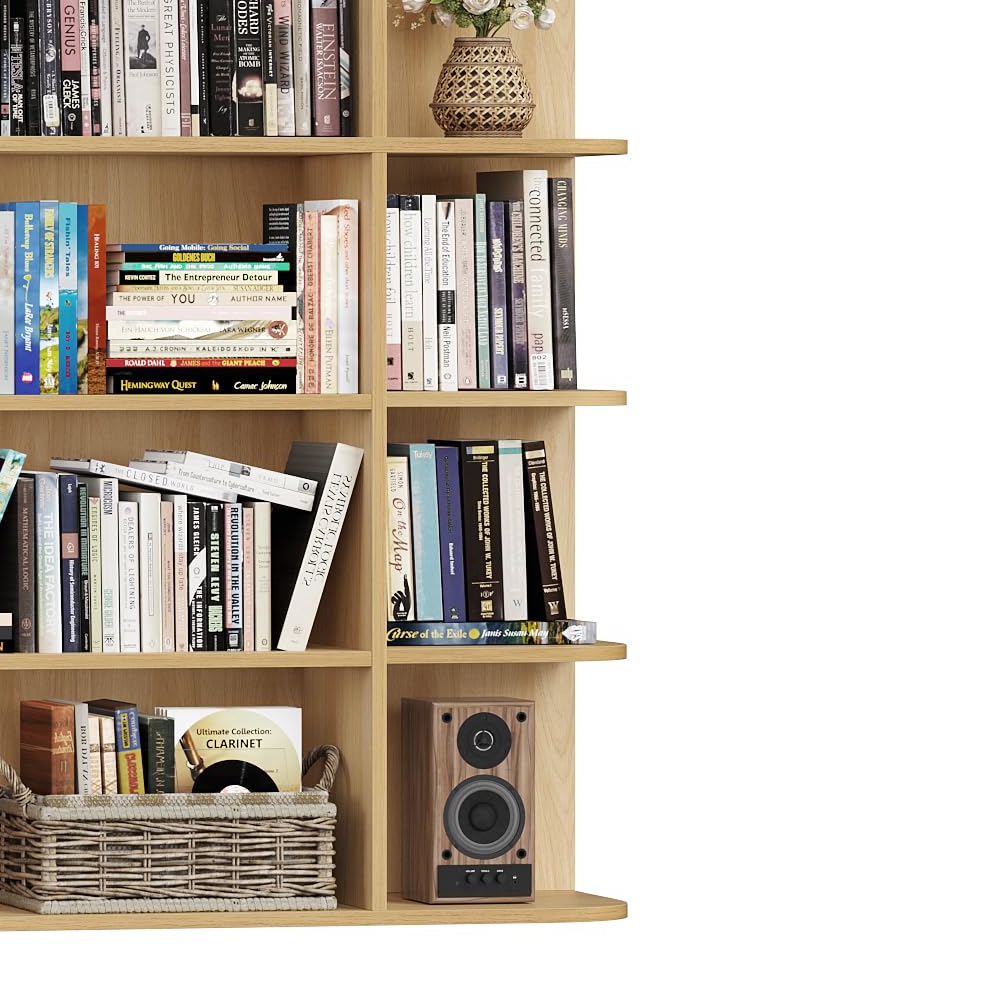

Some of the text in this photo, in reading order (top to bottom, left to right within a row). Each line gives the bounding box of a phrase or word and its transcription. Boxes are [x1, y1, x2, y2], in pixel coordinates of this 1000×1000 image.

[64, 6, 75, 55] GENIUS
[165, 43, 175, 115] PHYSICISTS
[280, 51, 290, 94] WIZARD
[323, 24, 336, 100] EINSTEIN
[529, 189, 545, 261] connected
[172, 294, 195, 303] YOU
[184, 274, 239, 282] Entrepreneur
[121, 380, 196, 390] HEMINGWAY QUEST
[206, 739, 262, 749] CLARINET
